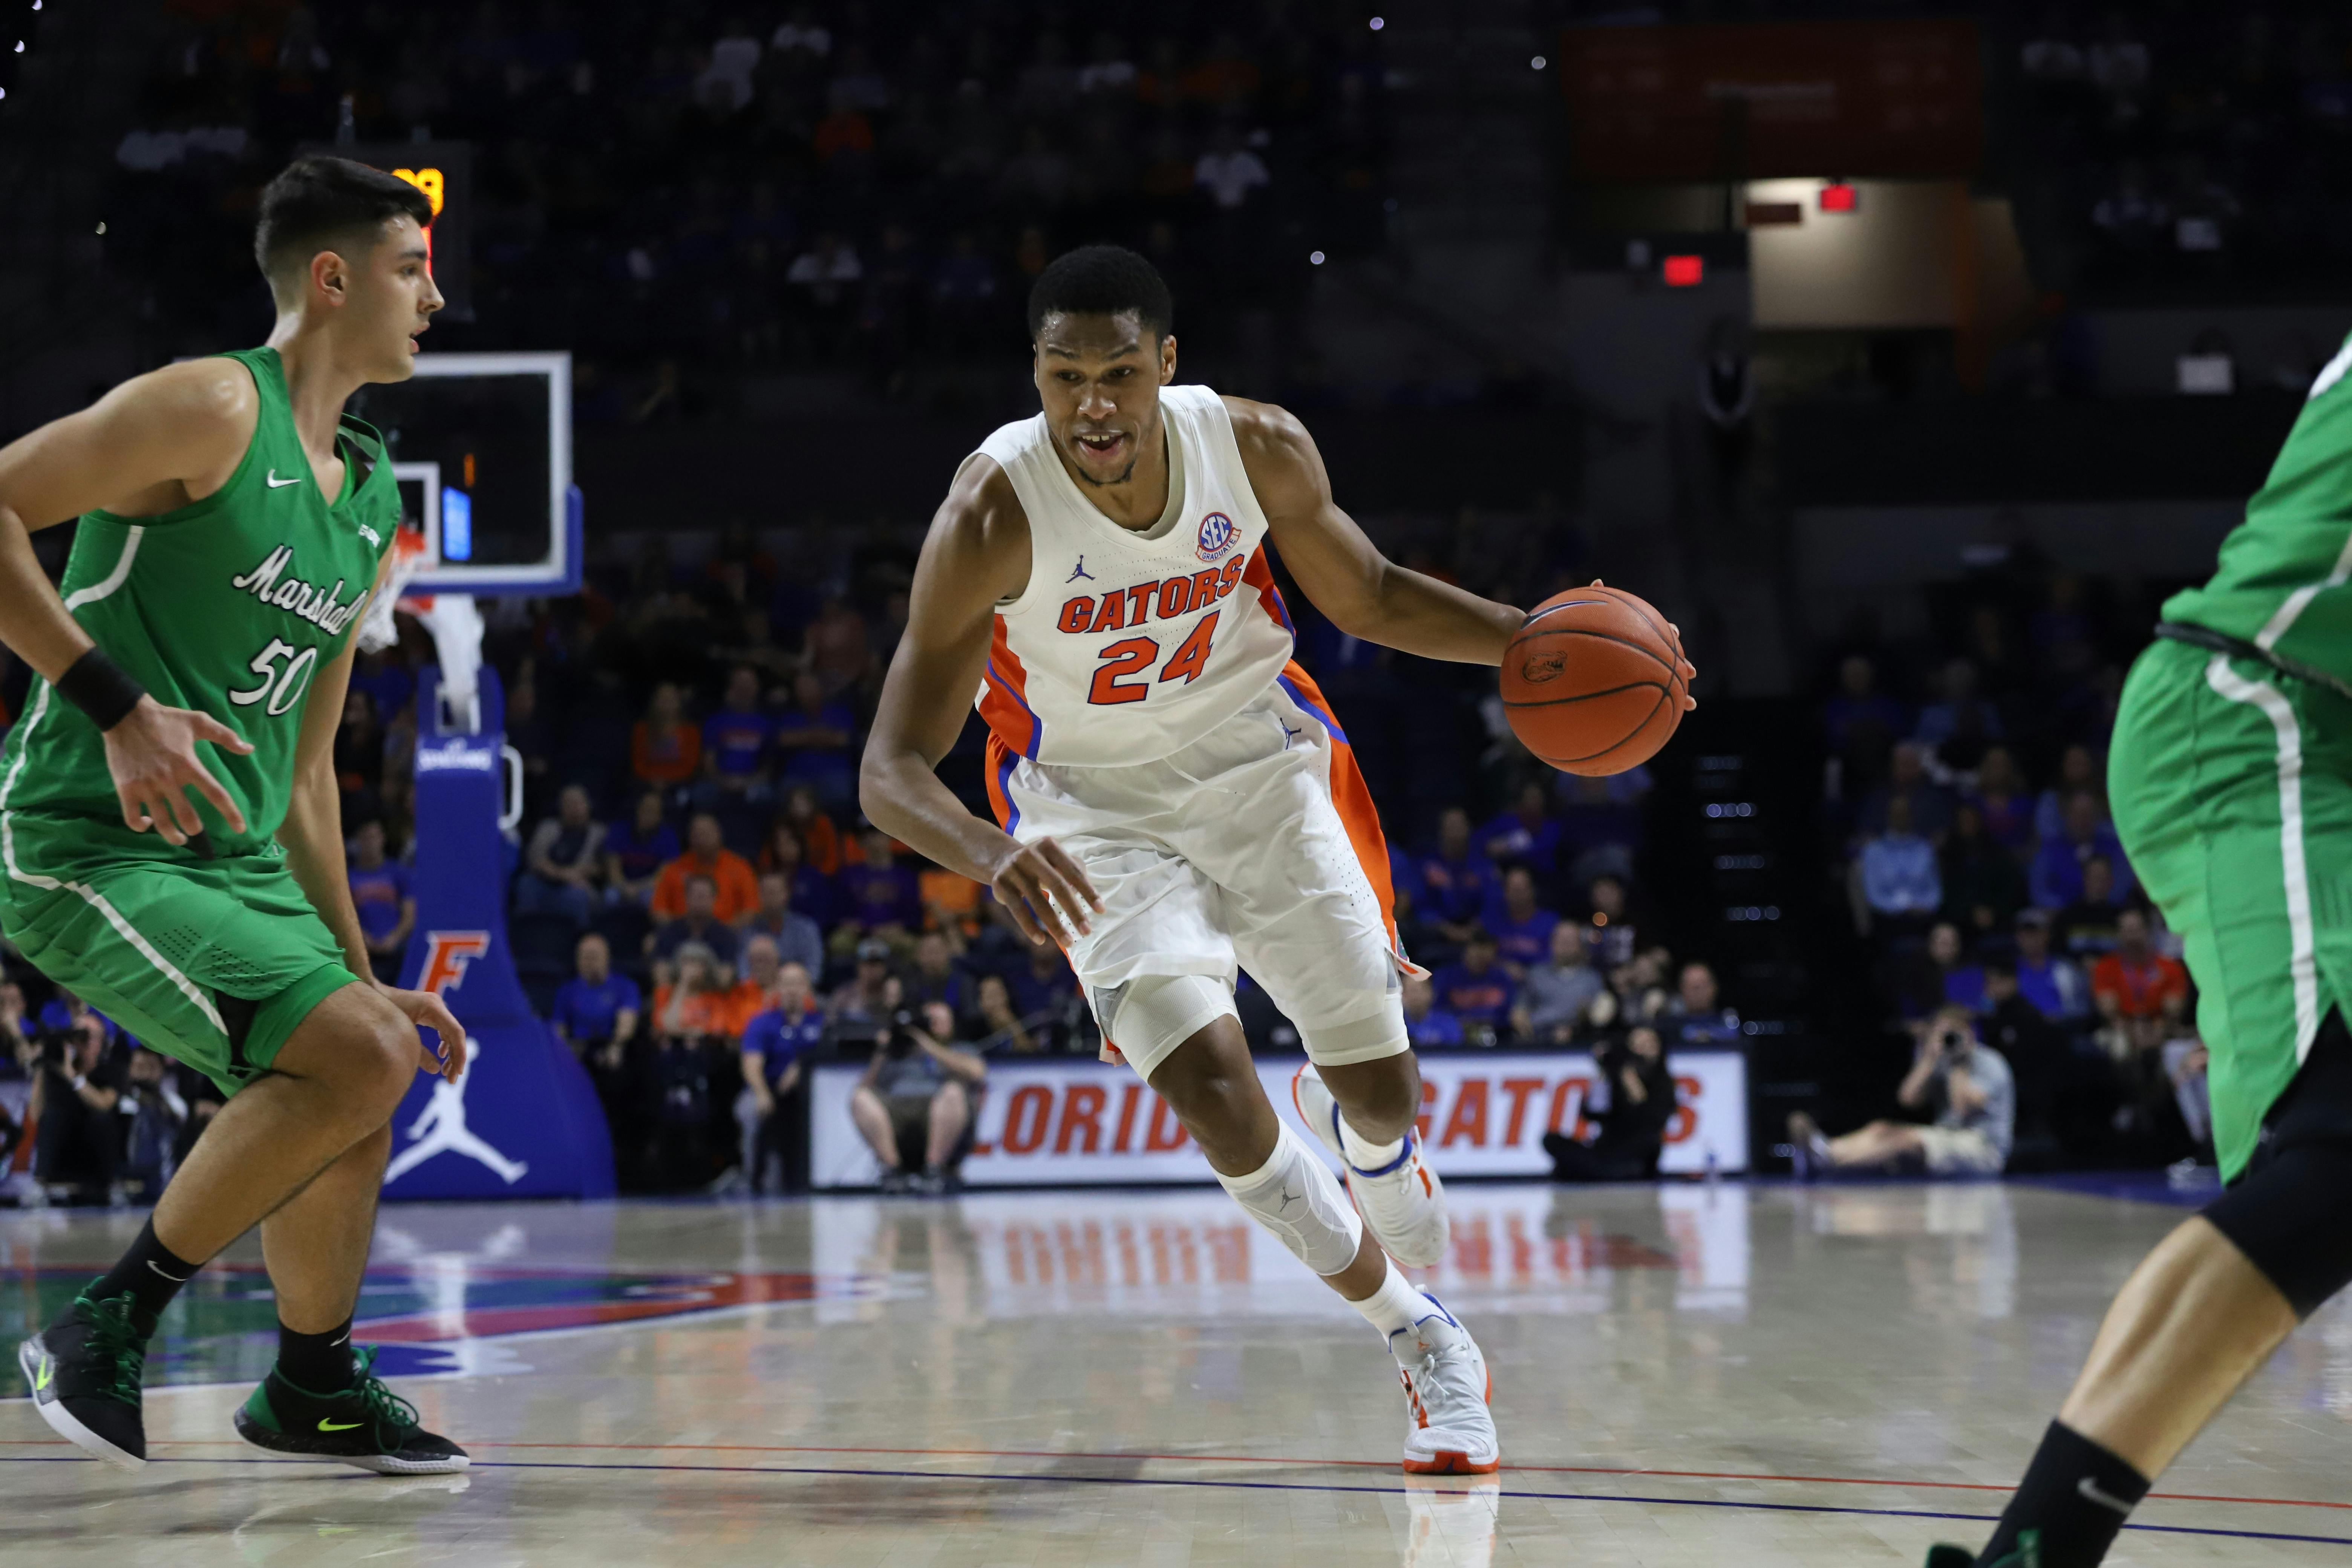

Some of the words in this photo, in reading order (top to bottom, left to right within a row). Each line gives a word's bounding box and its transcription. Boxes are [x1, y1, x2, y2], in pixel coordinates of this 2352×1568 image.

[1201, 516, 1230, 549] SEC
[1202, 538, 1236, 560] GRADUATE
[231, 543, 369, 636] Marshal
[1057, 553, 1245, 634] GATORS
[229, 637, 317, 716] 50
[1087, 609, 1221, 705] 24
[415, 930, 491, 995] F
[972, 1082, 1202, 1156] ORID
[1411, 1076, 1704, 1148] ATOS
